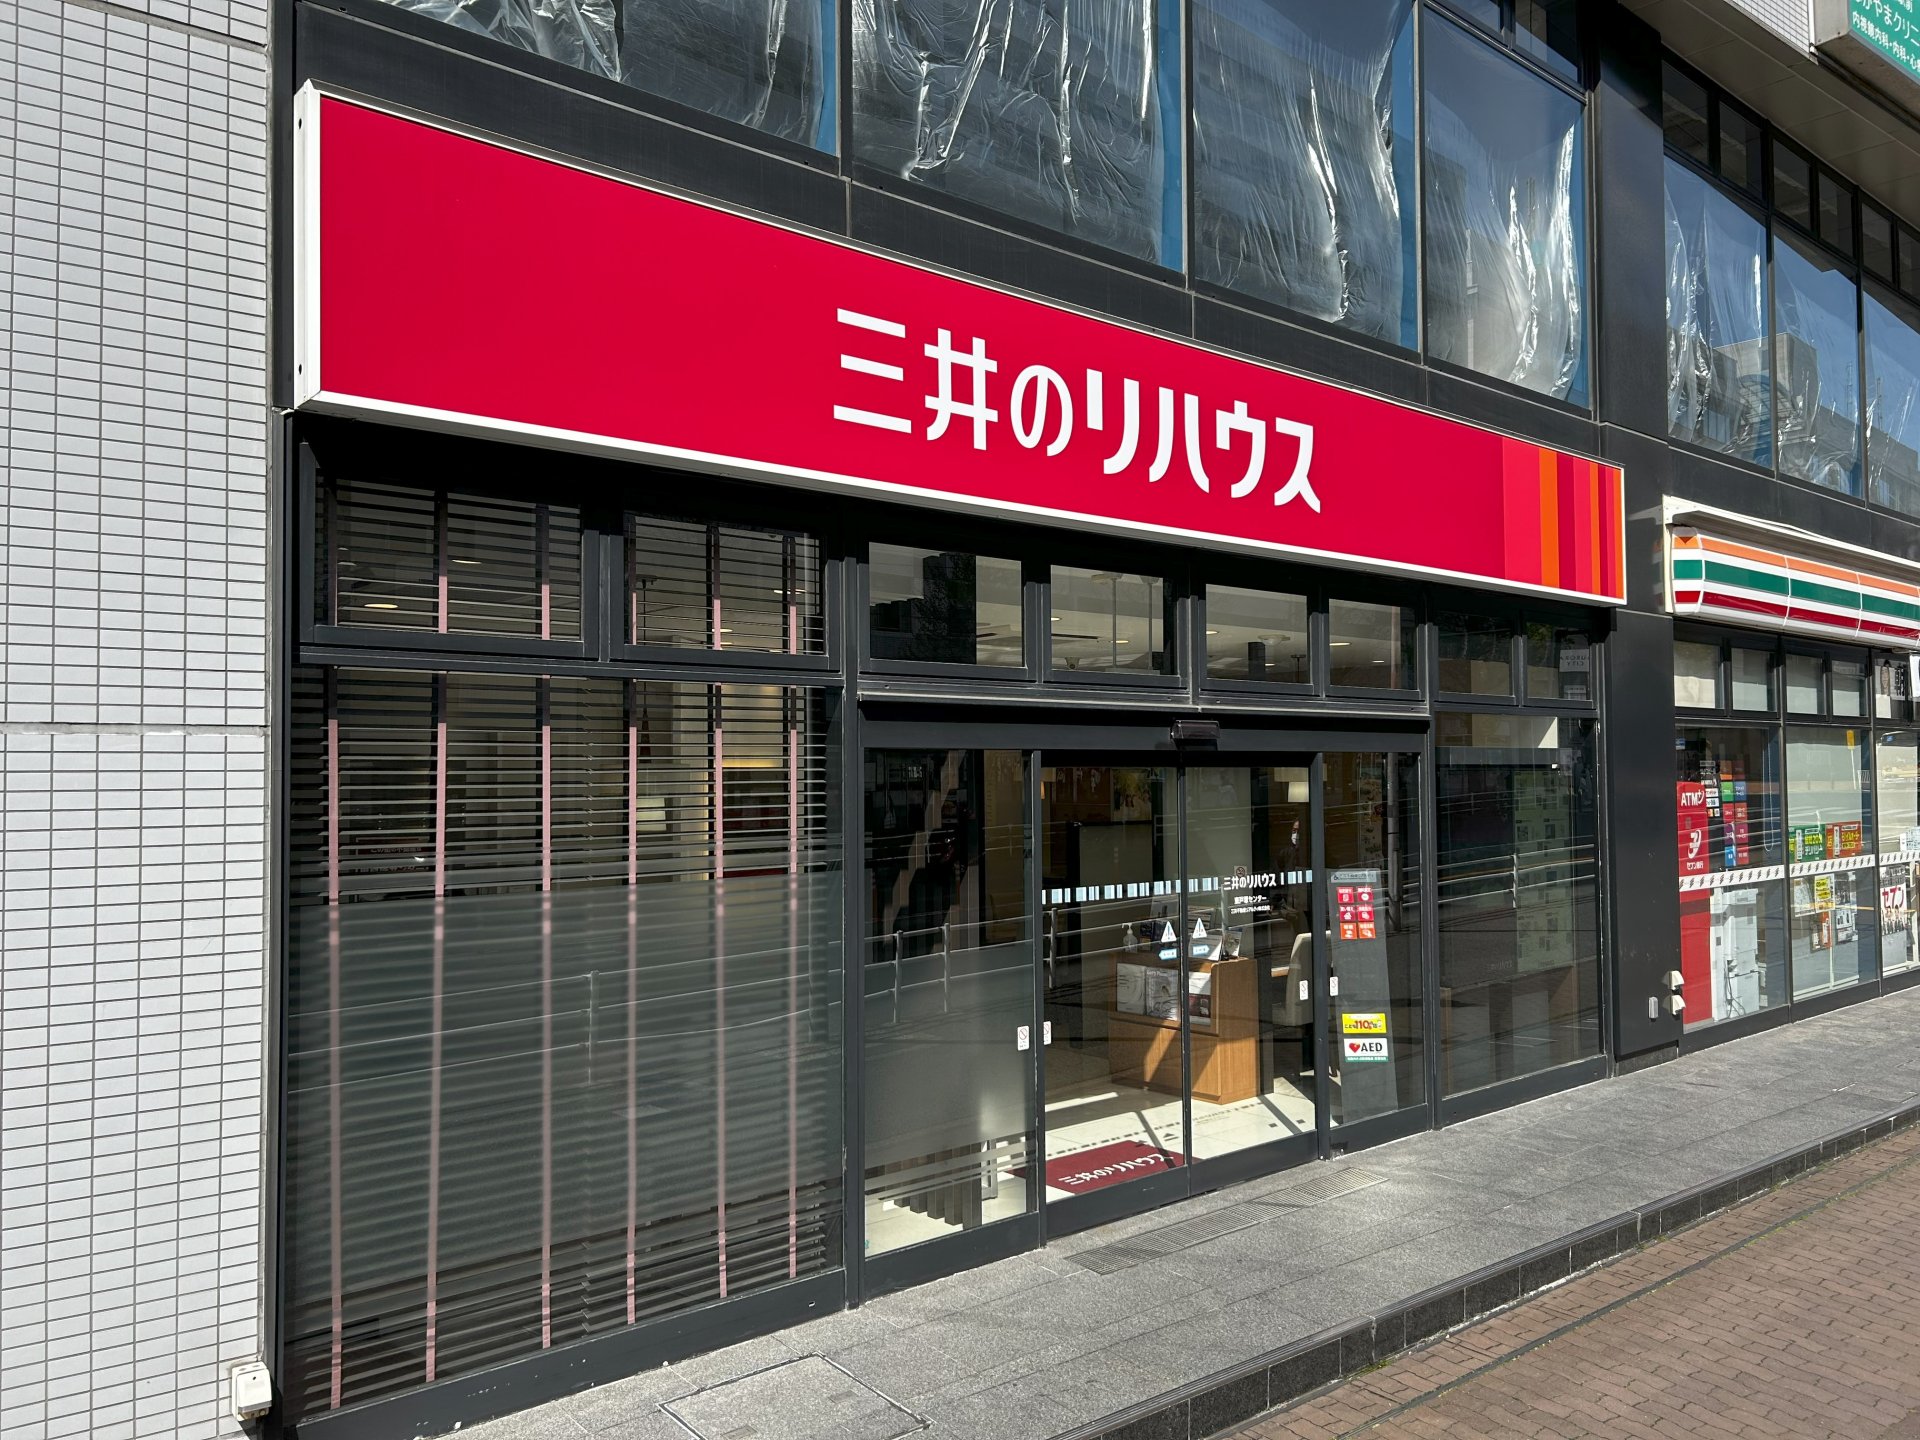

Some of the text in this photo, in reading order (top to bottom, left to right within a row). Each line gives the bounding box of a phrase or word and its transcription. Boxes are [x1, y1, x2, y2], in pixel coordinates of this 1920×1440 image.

[833, 308, 1321, 513] 三井のリハウス
[1223, 873, 1277, 890] 三井のリハウス
[1361, 1043, 1383, 1052] AED
[1058, 1153, 1174, 1185] 三井のリハウス
